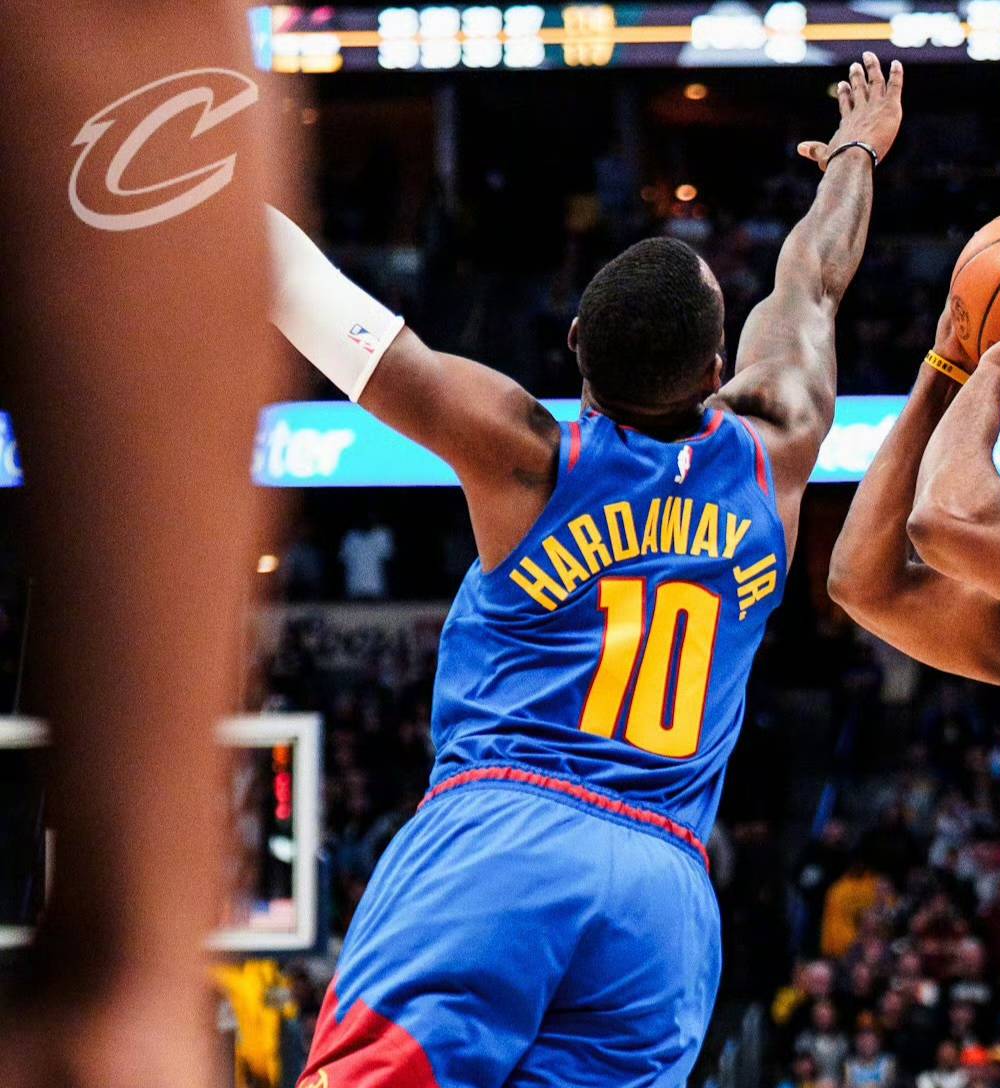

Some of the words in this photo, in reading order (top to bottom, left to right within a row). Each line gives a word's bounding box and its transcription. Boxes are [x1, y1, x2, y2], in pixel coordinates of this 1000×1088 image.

[508, 496, 752, 612] HARDAWAY
[732, 553, 778, 621] JR.
[577, 575, 721, 760] 10
